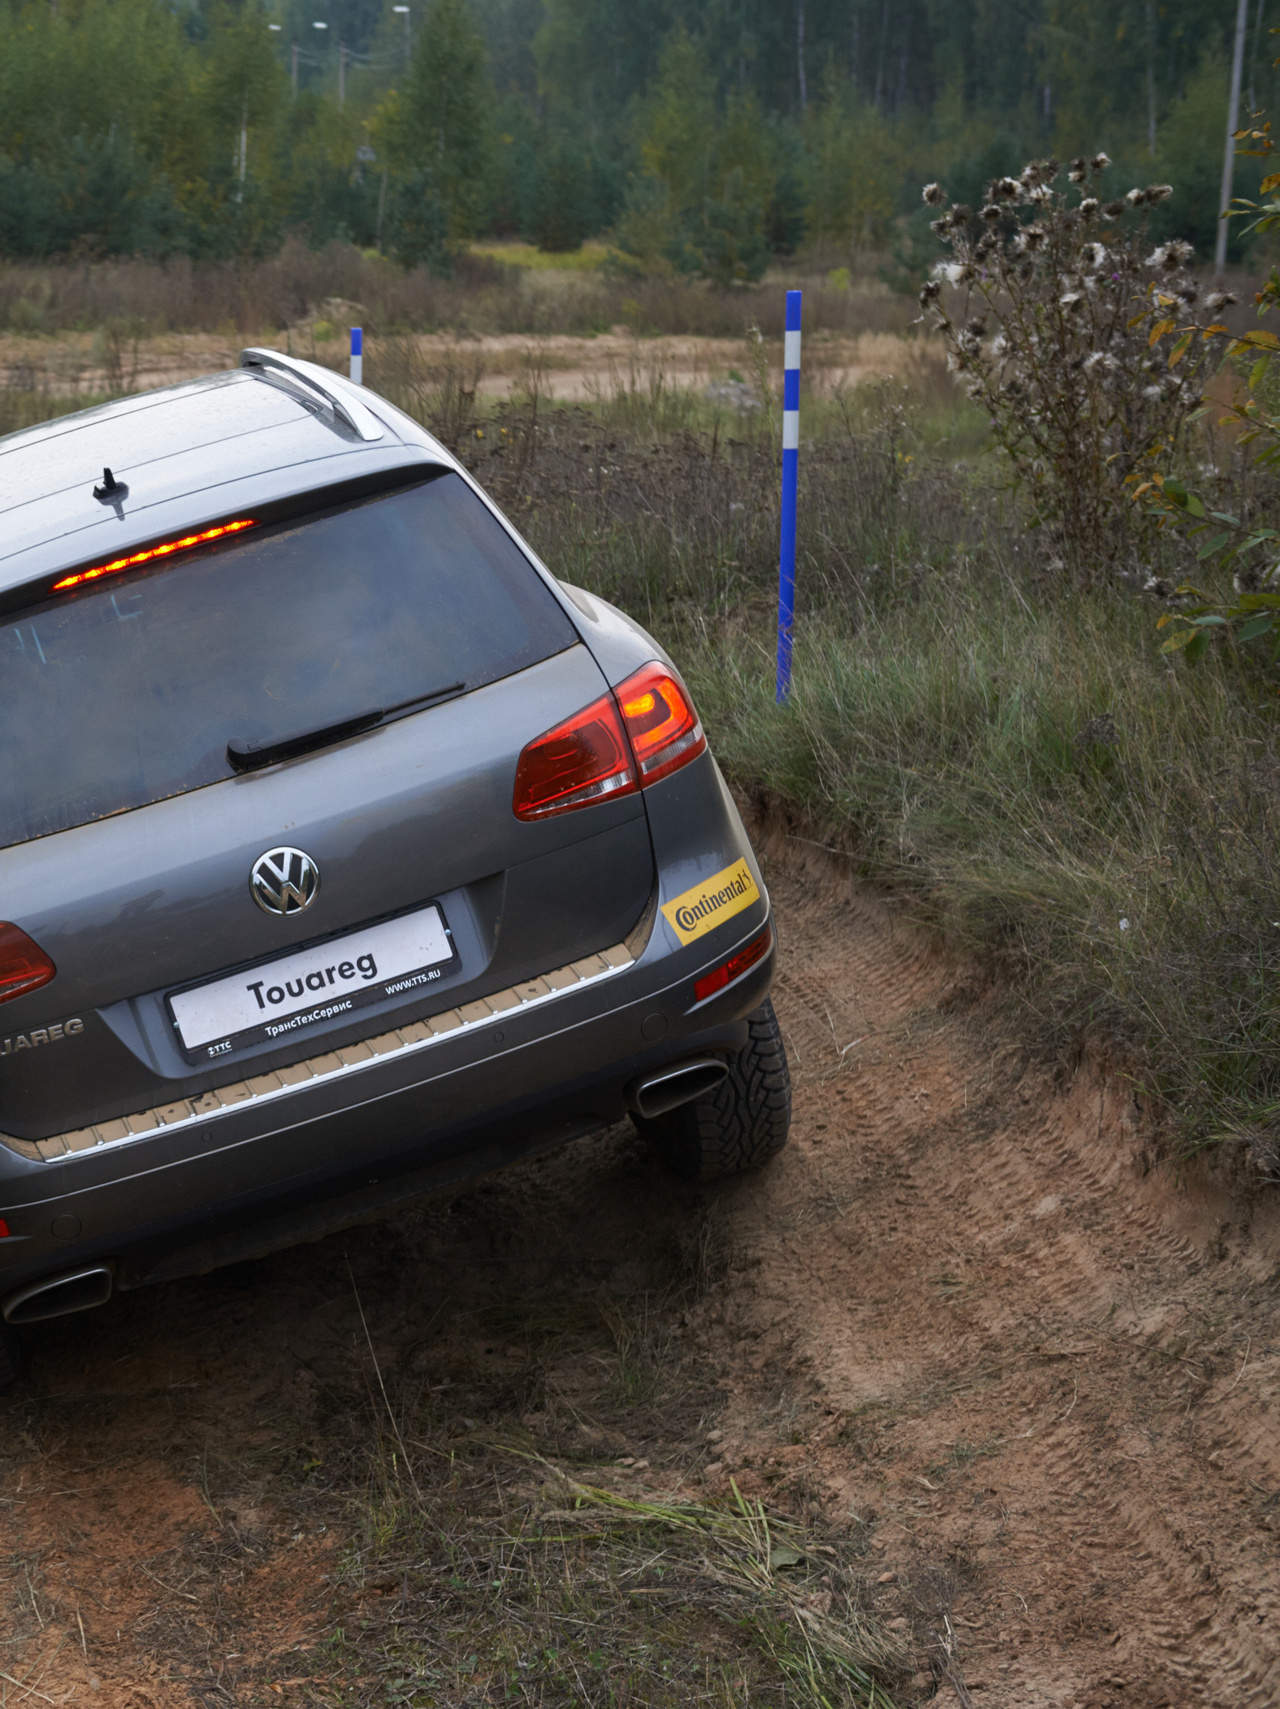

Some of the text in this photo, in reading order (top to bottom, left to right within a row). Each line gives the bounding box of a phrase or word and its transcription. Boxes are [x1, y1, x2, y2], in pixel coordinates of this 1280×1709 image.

[675, 873, 747, 932] Continental
[246, 953, 378, 1009] Touareg
[385, 970, 441, 995] WWW.TTS.RU
[265, 1001, 353, 1037] ТрансТехСервис
